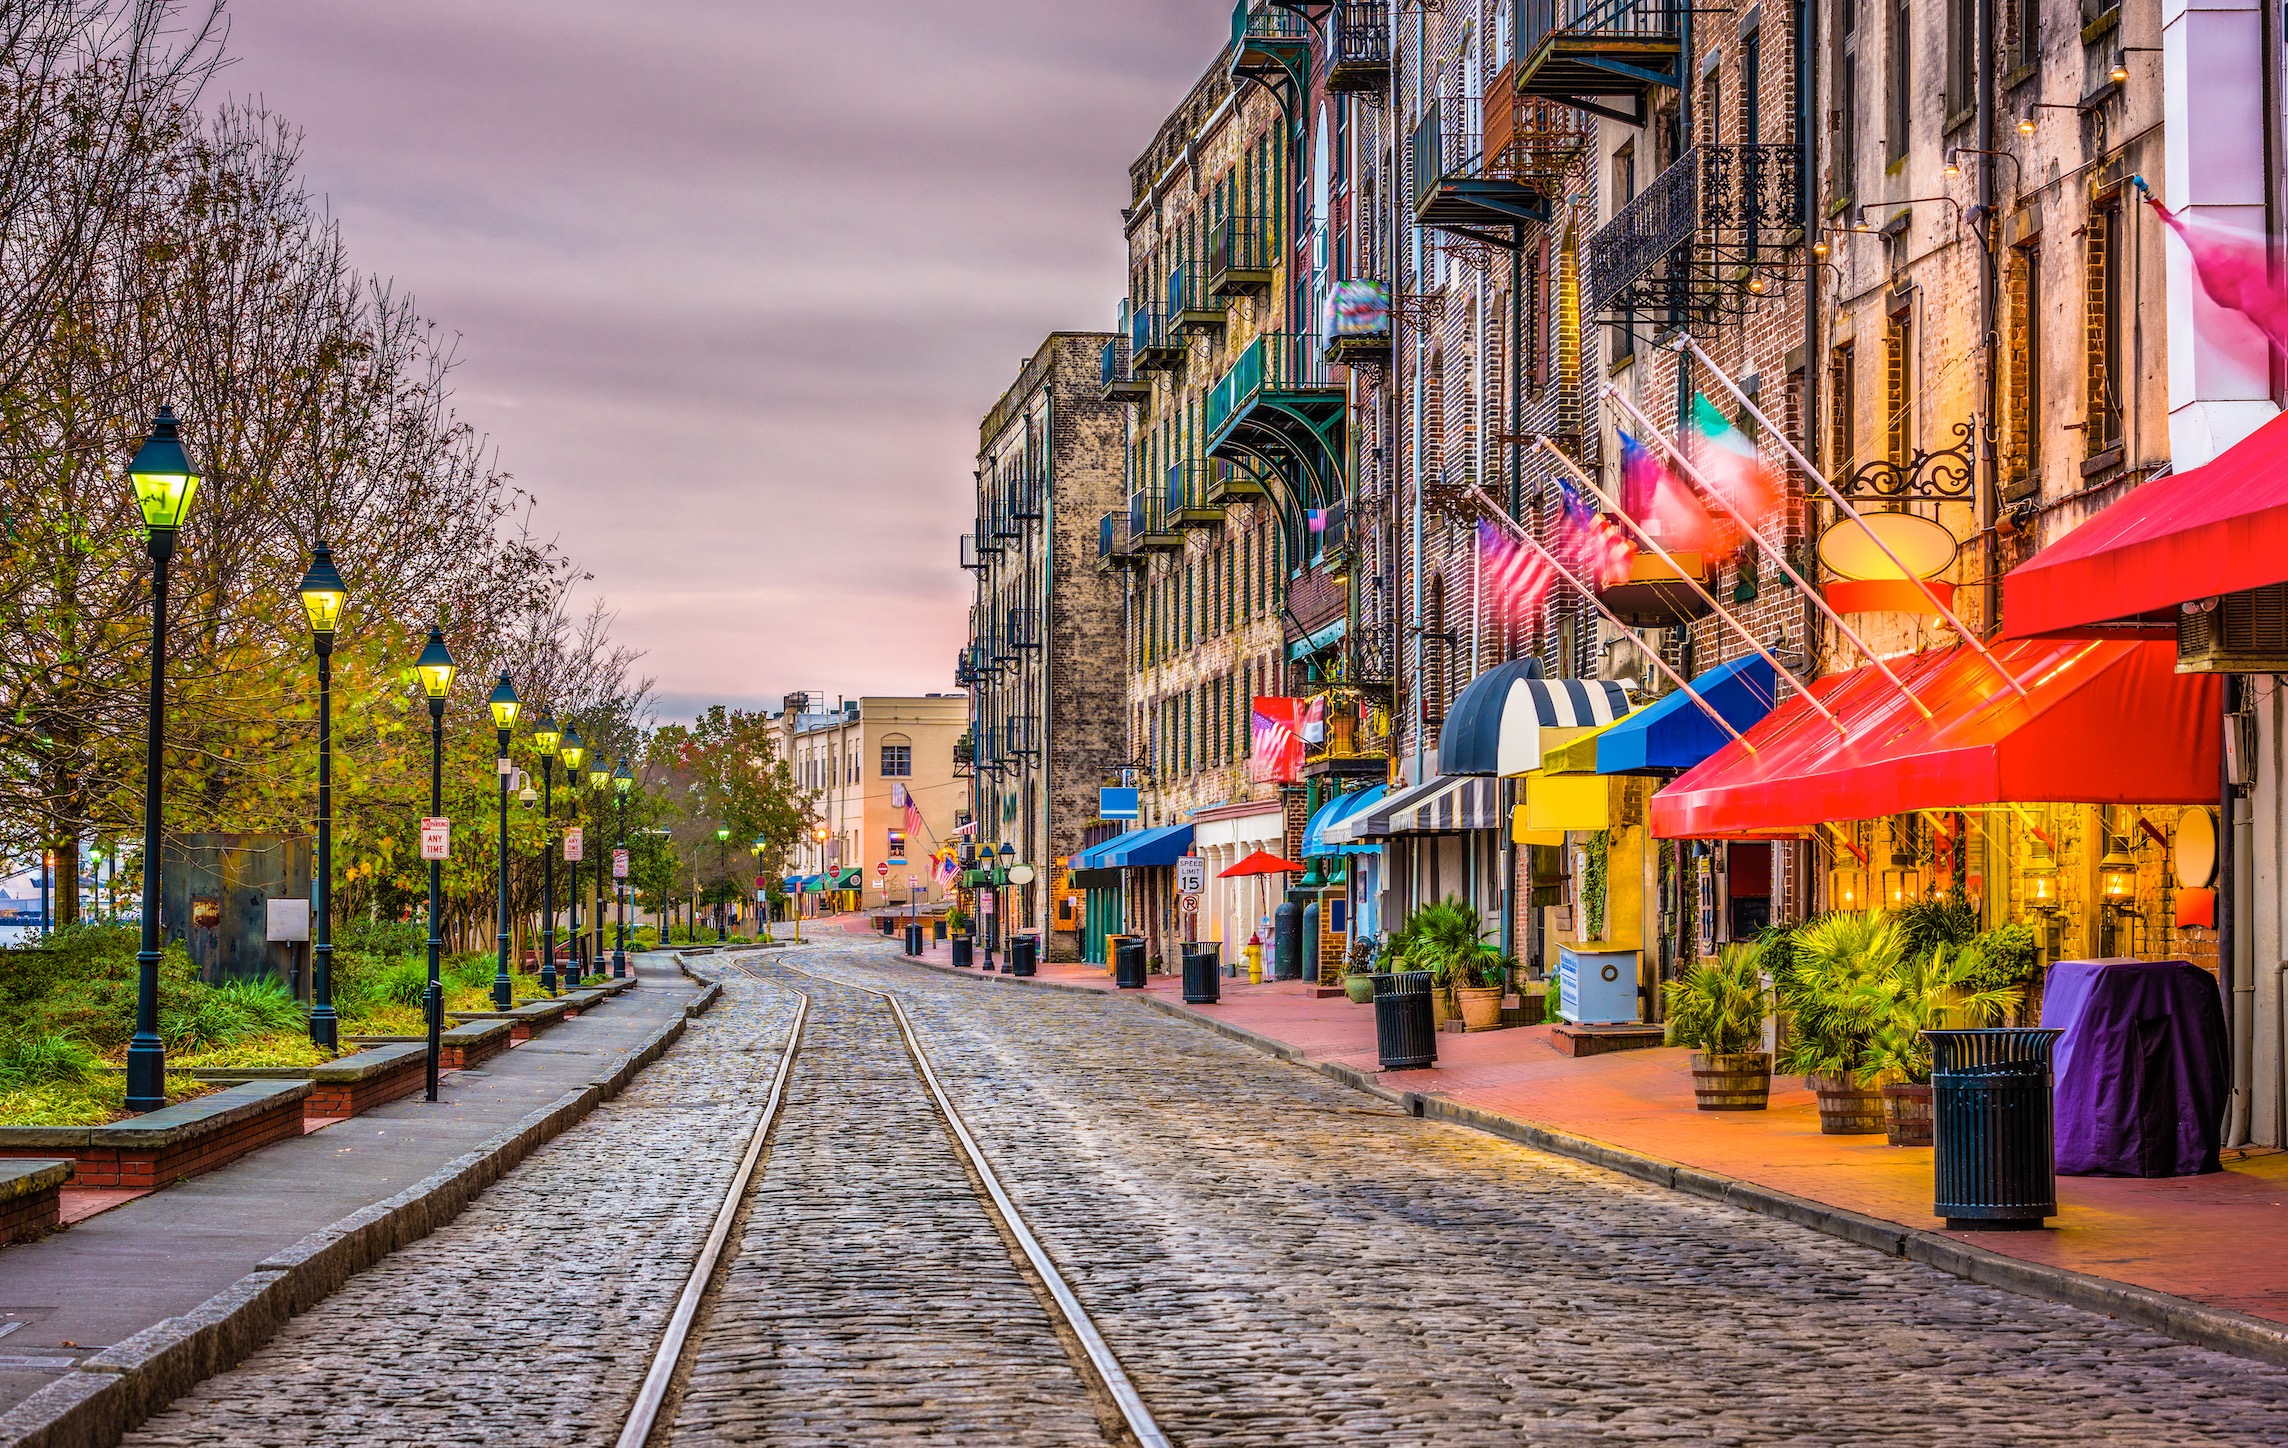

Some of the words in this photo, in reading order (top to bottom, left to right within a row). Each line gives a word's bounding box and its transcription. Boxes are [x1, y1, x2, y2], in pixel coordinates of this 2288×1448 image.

[422, 820, 430, 829] NO
[428, 835, 443, 843] ANY
[427, 845, 444, 854] TIME
[1182, 876, 1200, 890] 15
